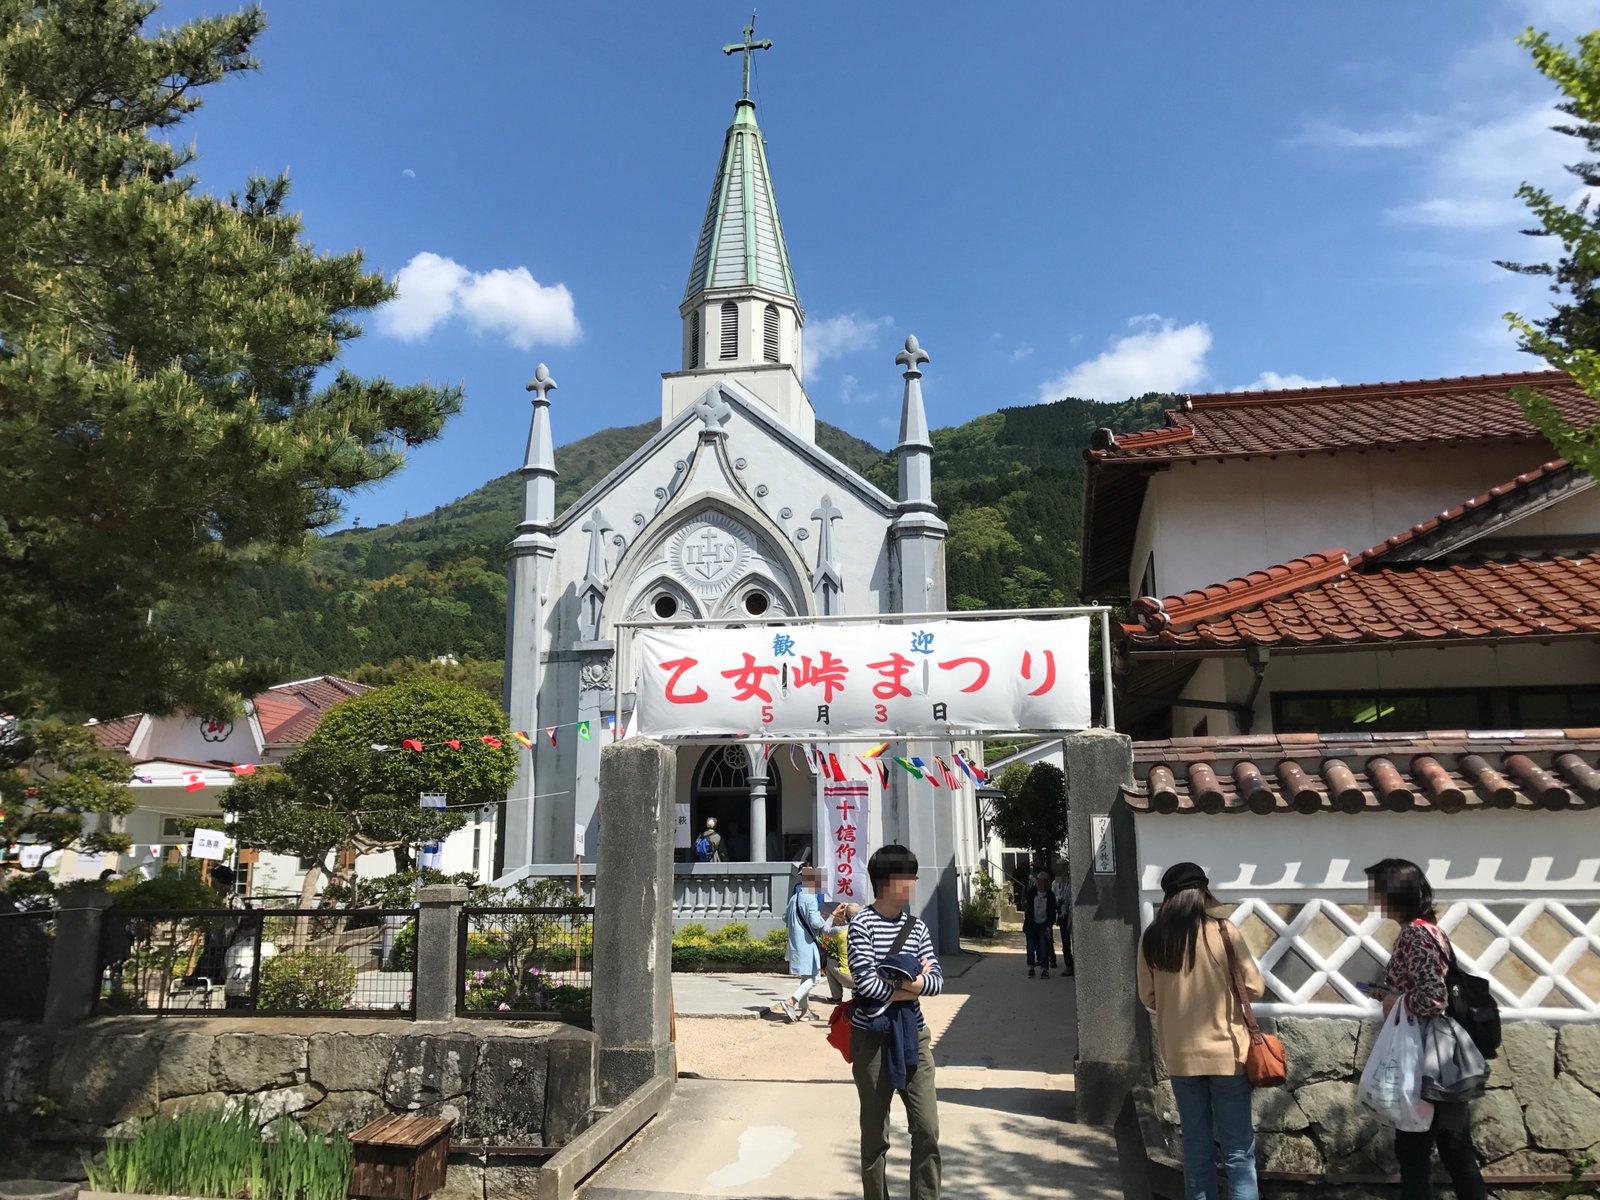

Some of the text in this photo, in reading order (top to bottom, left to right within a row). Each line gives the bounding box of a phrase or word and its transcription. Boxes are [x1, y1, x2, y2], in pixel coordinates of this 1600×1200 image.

[686, 543, 736, 565] IHS
[658, 649, 1057, 704] 乙女峠まつり
[761, 702, 948, 725] 5月3日
